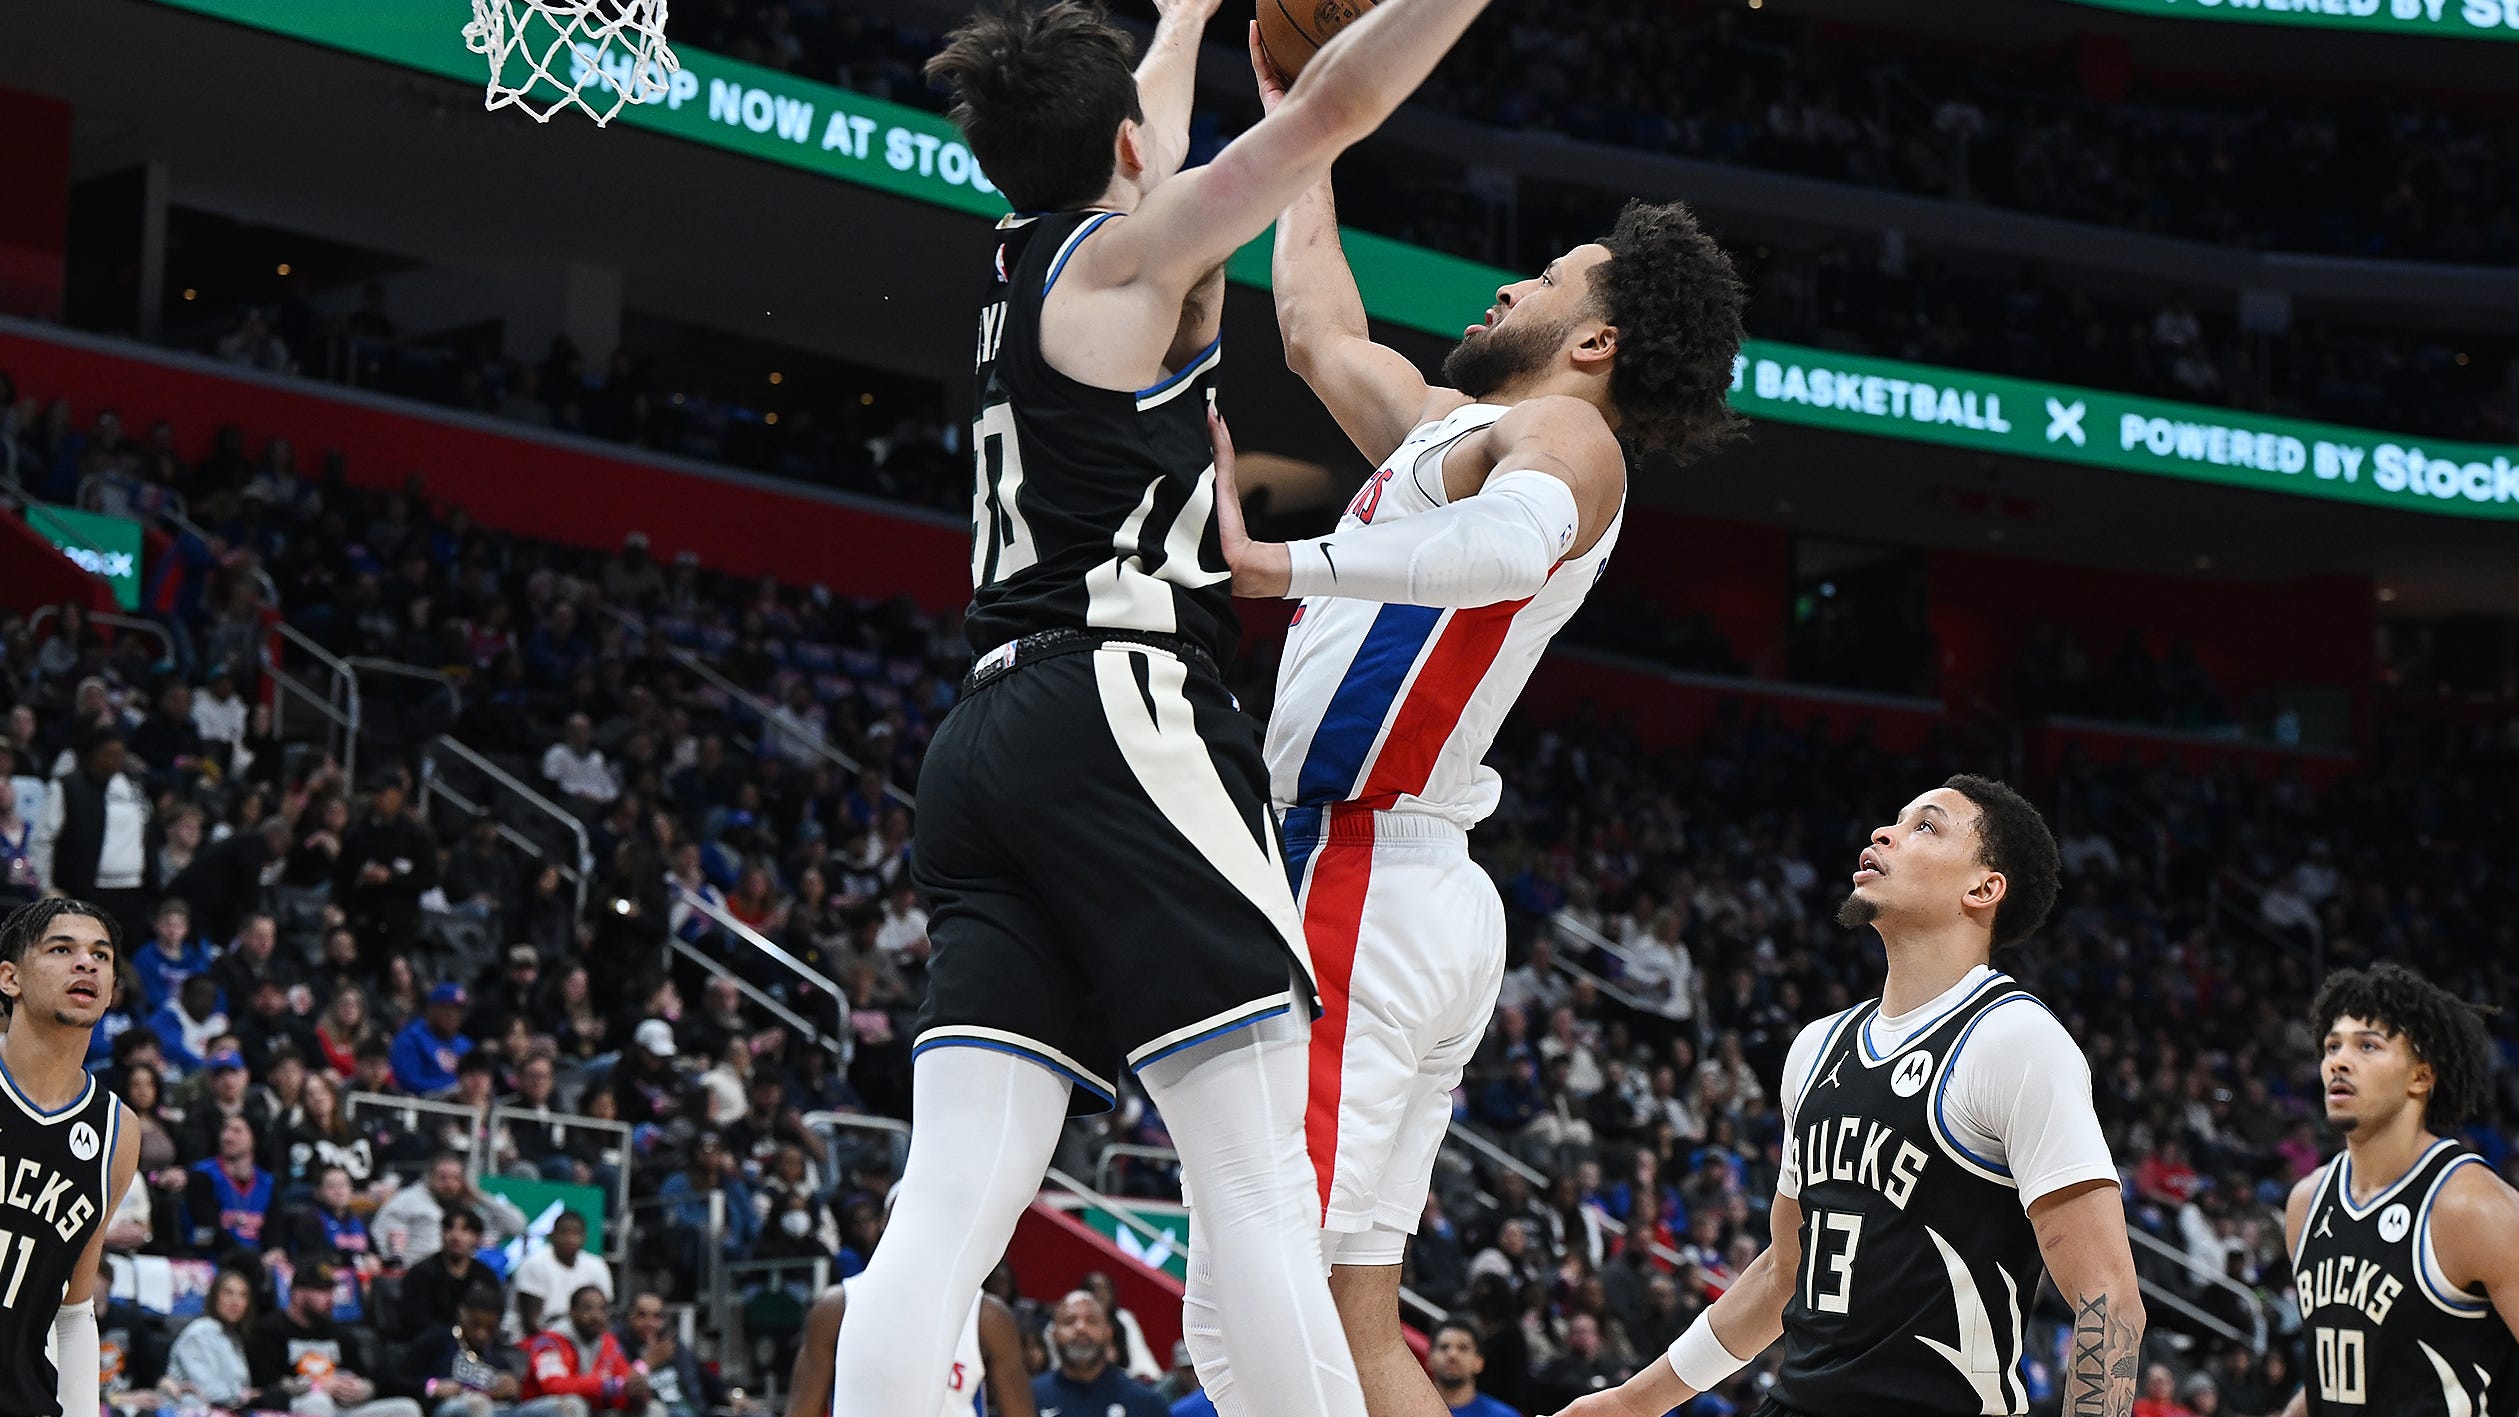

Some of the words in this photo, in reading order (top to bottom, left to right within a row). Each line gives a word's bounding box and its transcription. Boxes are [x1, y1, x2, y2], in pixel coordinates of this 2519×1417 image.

[570, 42, 699, 110] SHOP
[709, 78, 815, 144] NOW
[821, 110, 877, 160] AT
[885, 127, 1006, 198] STO
[1755, 359, 2011, 434] BASKETBALL
[2120, 413, 2306, 474] POWERED
[2313, 441, 2365, 482] BY
[0, 1155, 95, 1243] CKS
[1792, 1117, 1930, 1211] BUCKS
[1806, 1210, 1862, 1314] 13
[2297, 1255, 2403, 1326] BUCKS
[2316, 1327, 2366, 1405] 00
